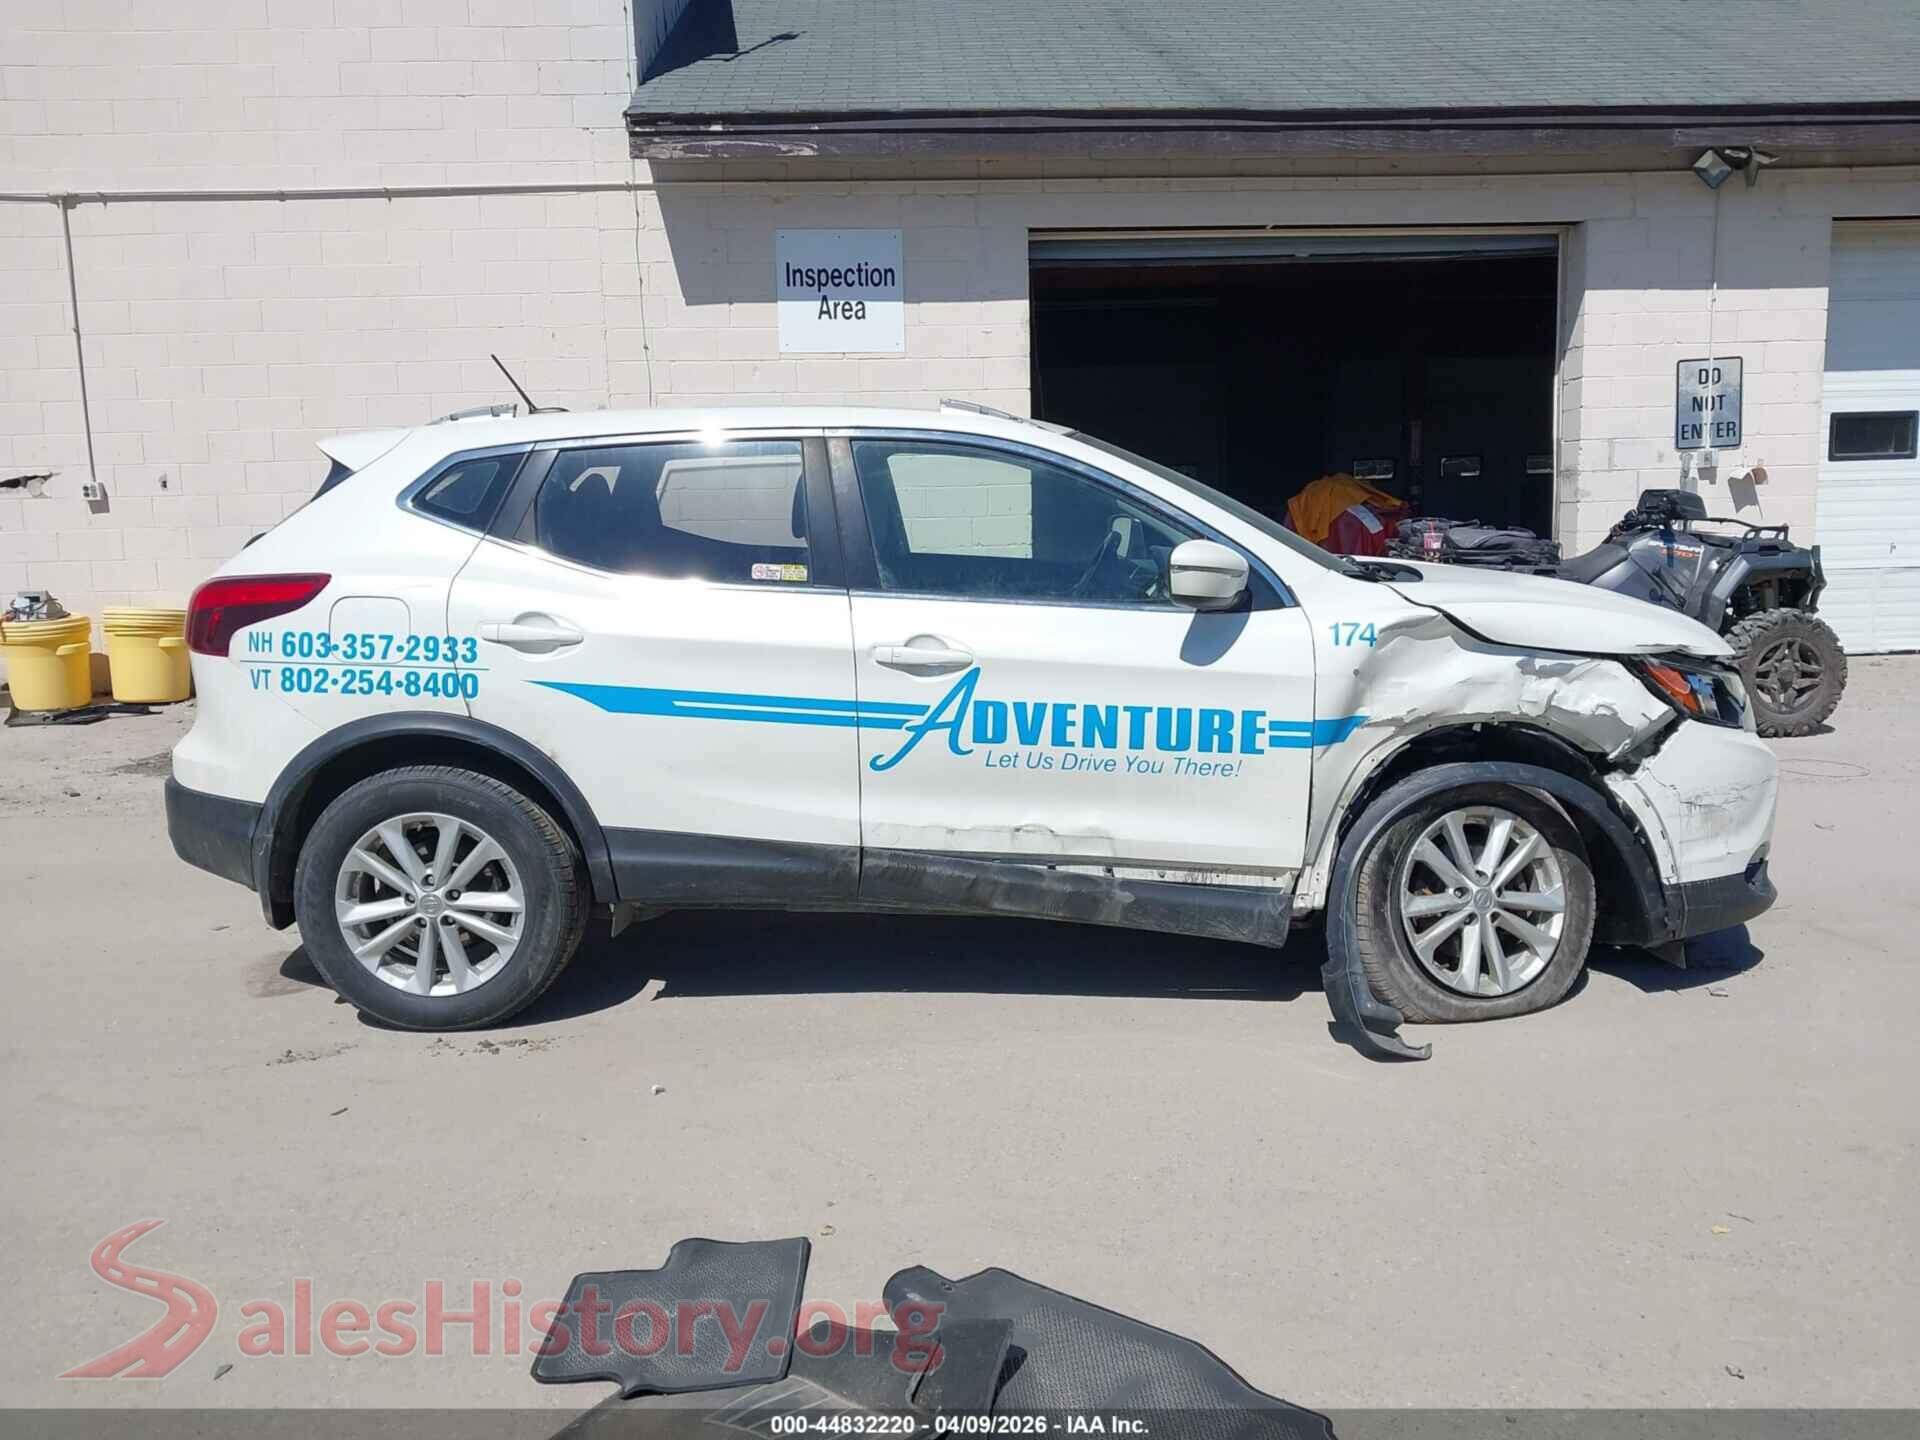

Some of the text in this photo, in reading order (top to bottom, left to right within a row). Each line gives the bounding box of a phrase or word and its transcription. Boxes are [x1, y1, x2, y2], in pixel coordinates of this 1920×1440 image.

[785, 261, 896, 293] Inspection
[817, 294, 866, 320] Area
[1698, 367, 1721, 385] DO
[1692, 394, 1726, 412] NOT
[248, 631, 273, 653] NH
[1328, 622, 1377, 647] 174
[250, 669, 272, 690] VT
[869, 666, 1267, 772] ADVENTURE
[985, 750, 1243, 778] Let Us Drive You There!
